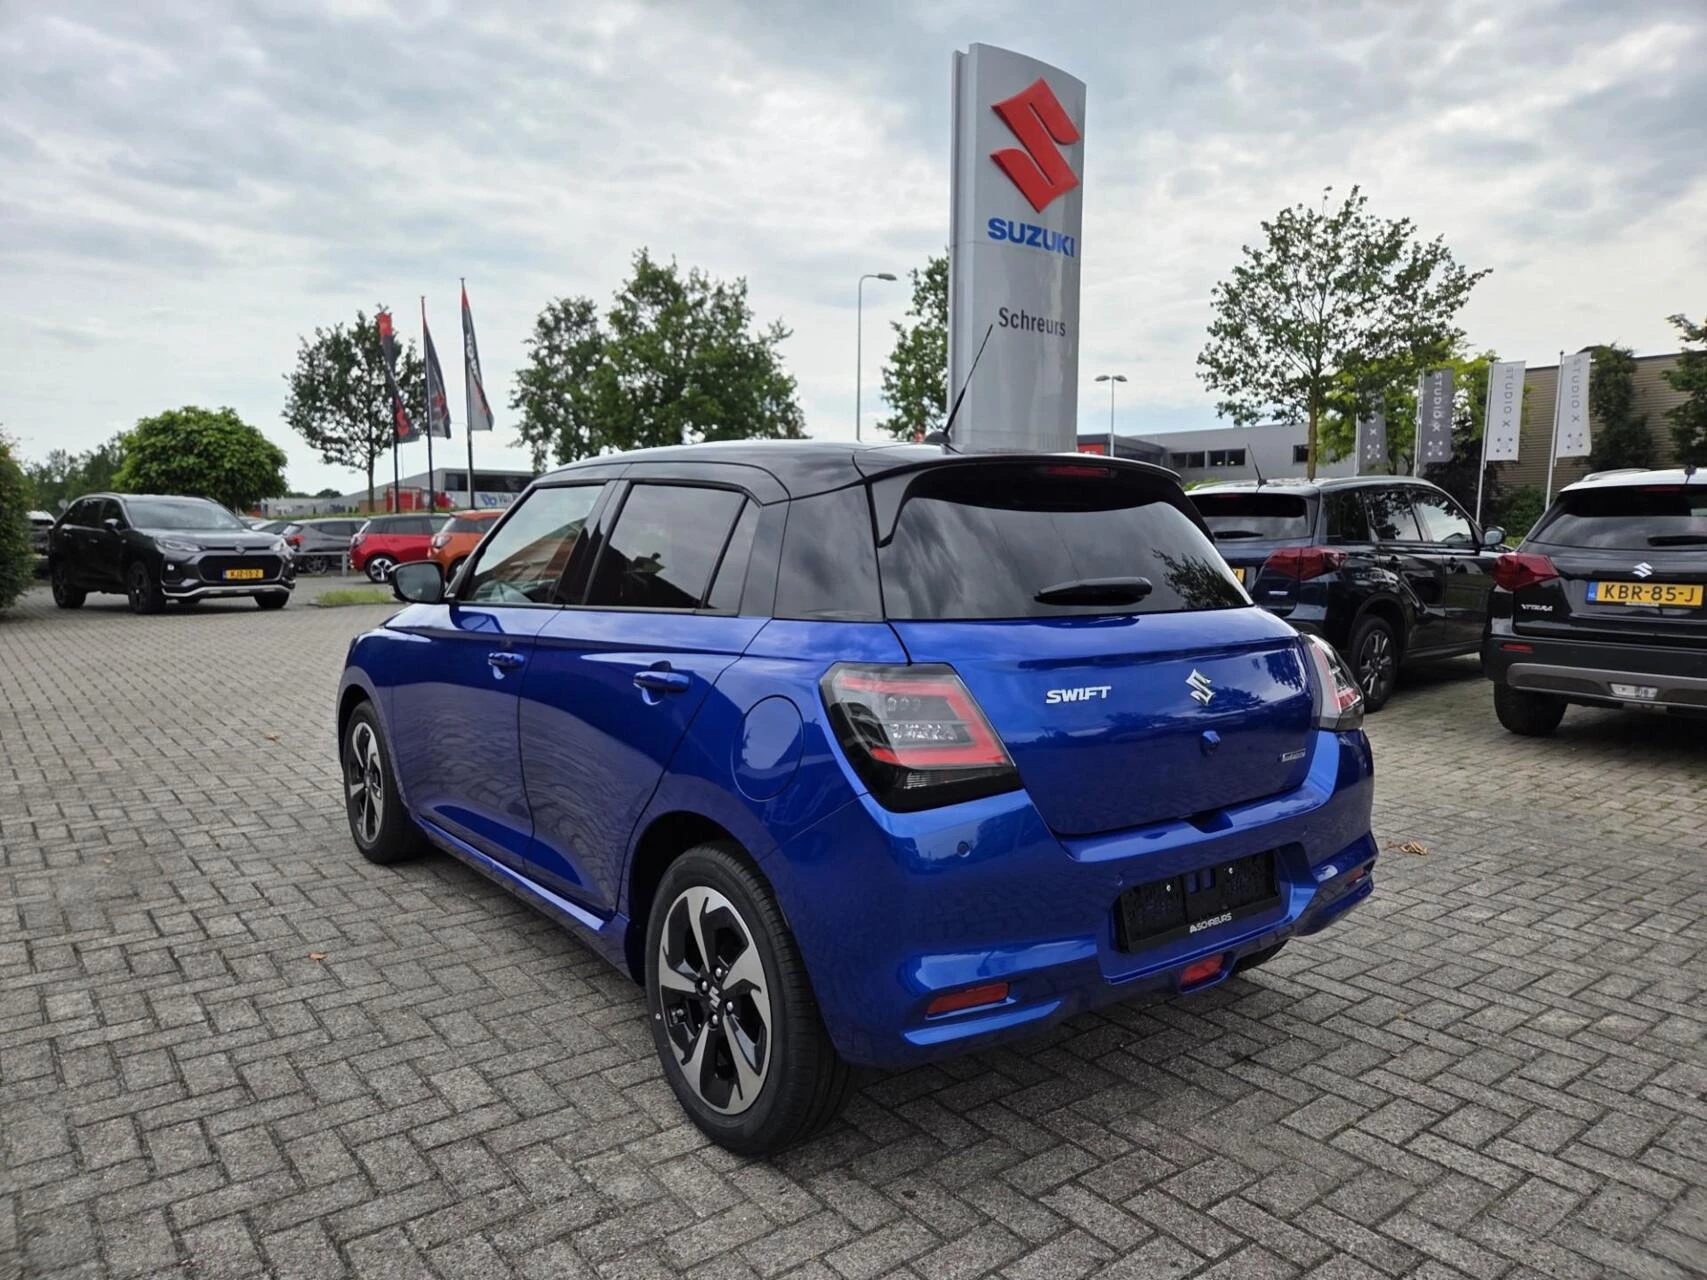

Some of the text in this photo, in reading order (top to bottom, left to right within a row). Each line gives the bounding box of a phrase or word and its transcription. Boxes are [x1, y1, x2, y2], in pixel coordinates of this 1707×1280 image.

[987, 217, 1075, 258] SUZUKI
[998, 306, 1066, 337] Schreurs
[1432, 371, 1443, 419] STUDIO
[1502, 366, 1514, 428] STUDIO X
[1571, 414, 1579, 423] X
[1603, 583, 1695, 603] KBR-85-J
[1045, 685, 1112, 704] SWIFT
